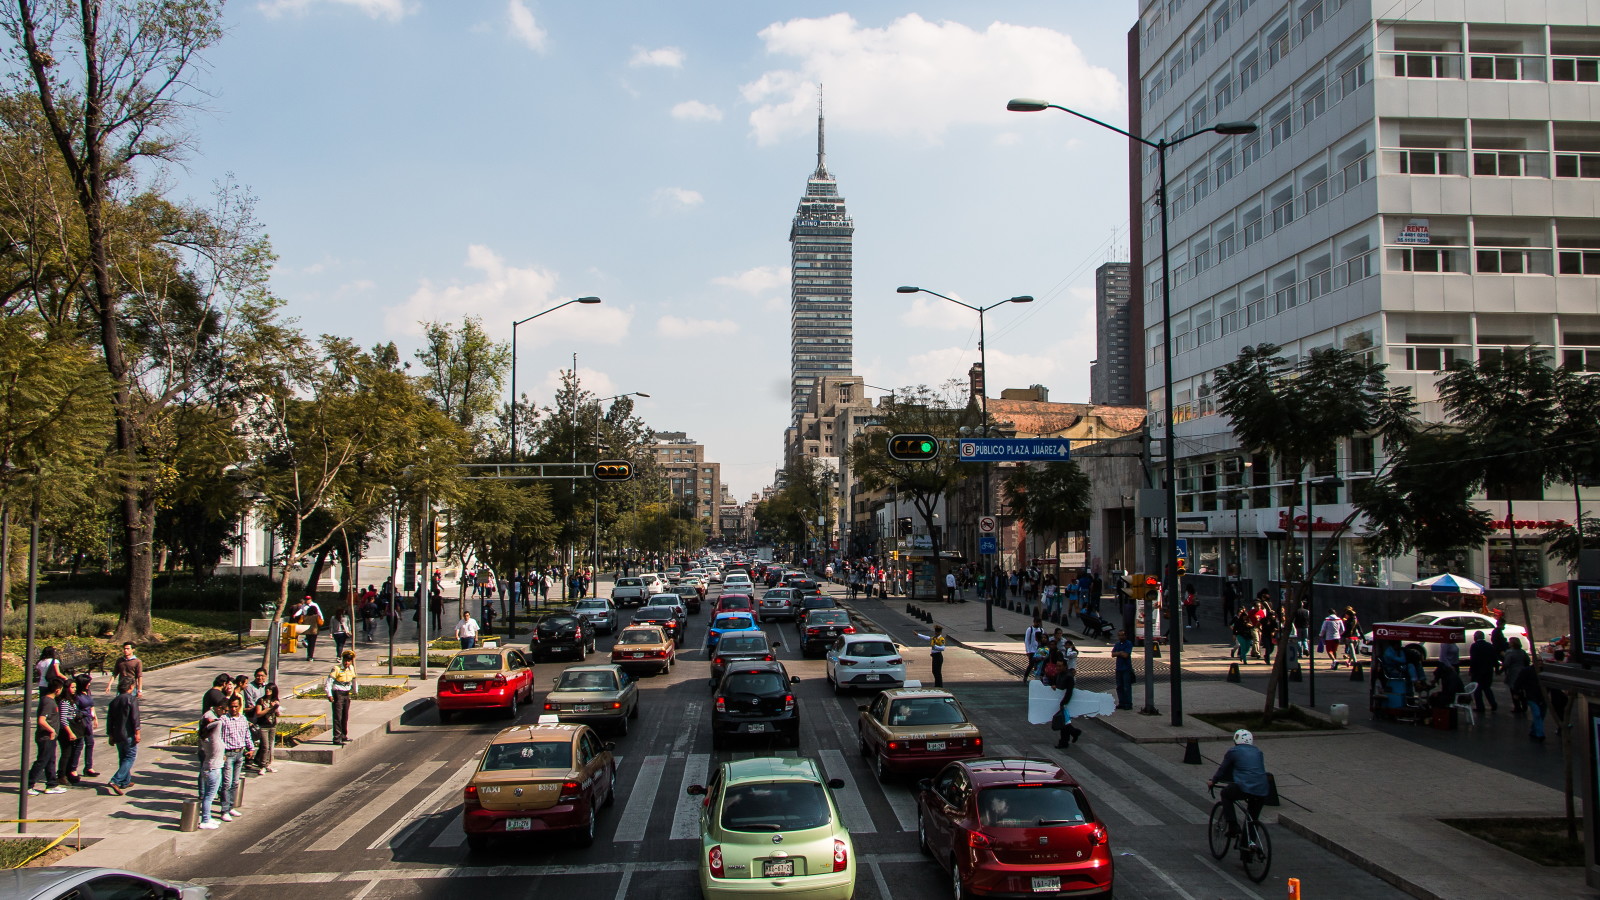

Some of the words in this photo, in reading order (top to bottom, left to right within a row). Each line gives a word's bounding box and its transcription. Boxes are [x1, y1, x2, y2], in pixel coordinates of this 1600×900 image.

[975, 442, 1005, 455] PÚBLICO
[1006, 445, 1030, 455] PLAZA
[1031, 442, 1058, 455] JUÁREZ
